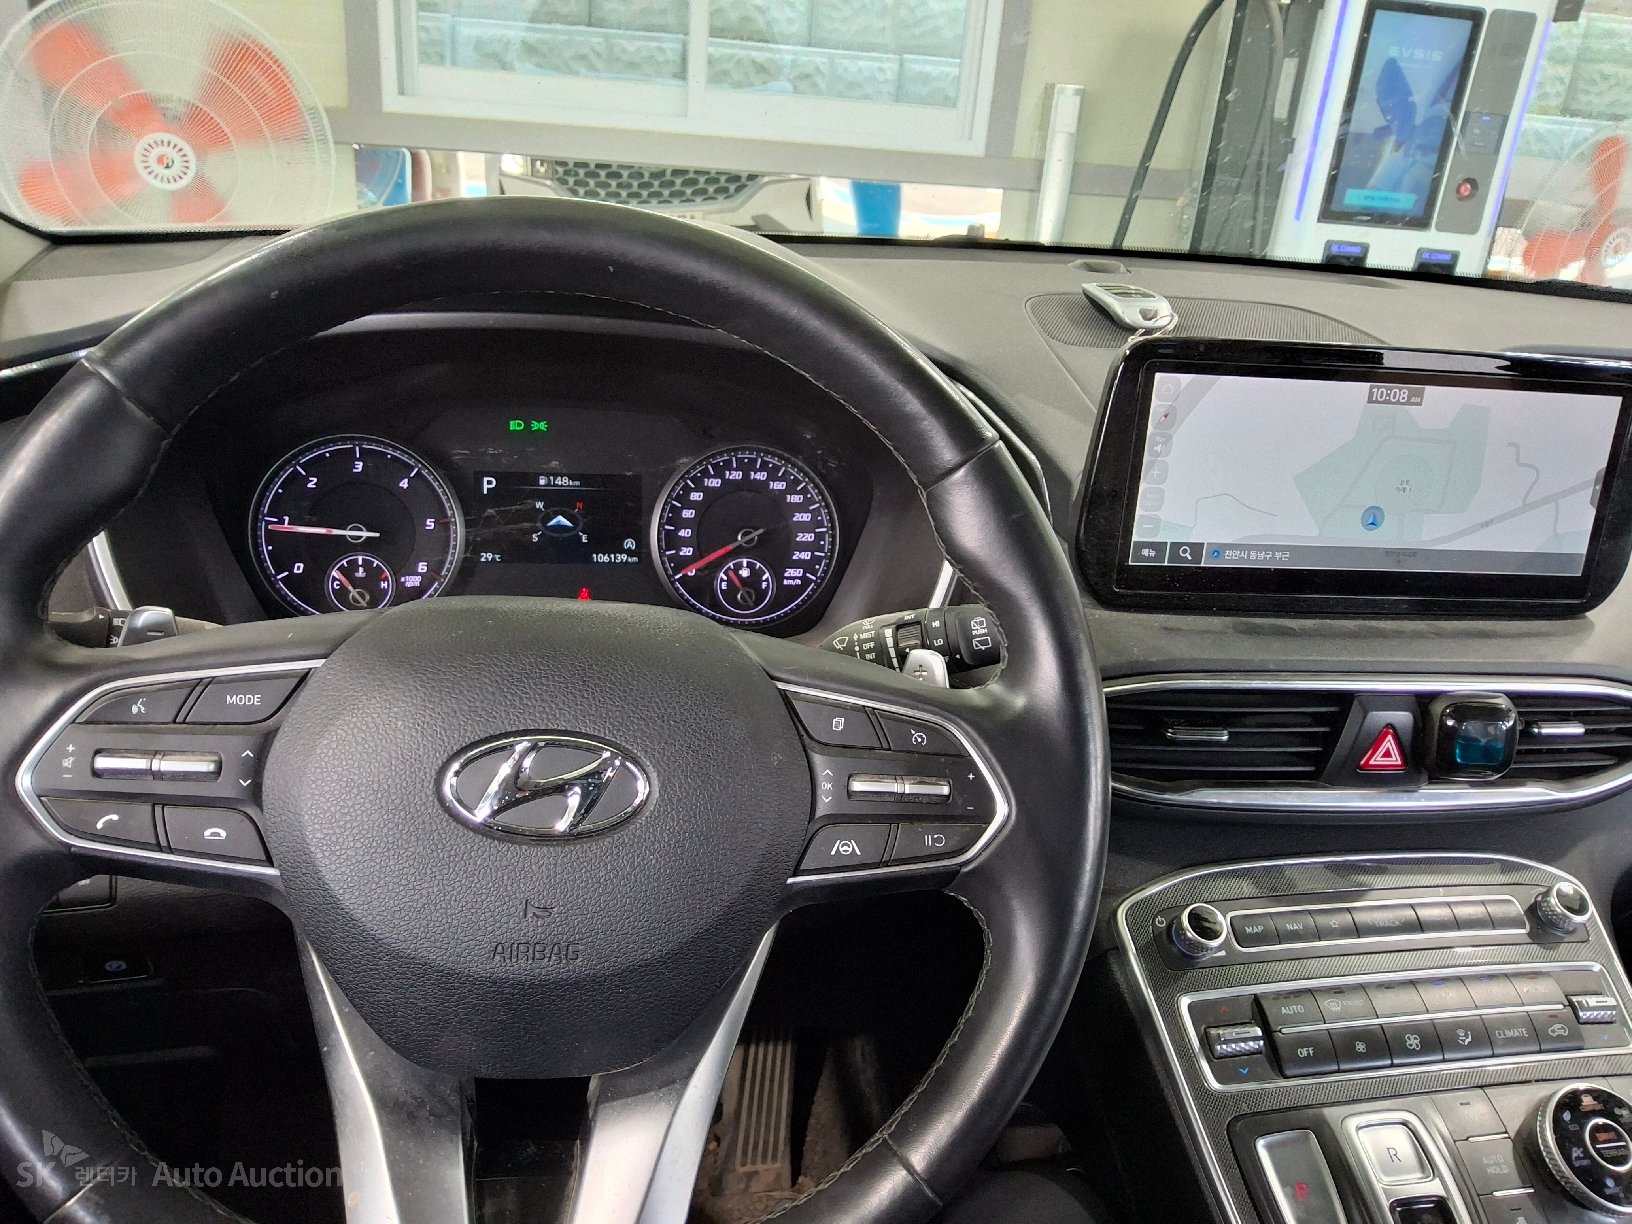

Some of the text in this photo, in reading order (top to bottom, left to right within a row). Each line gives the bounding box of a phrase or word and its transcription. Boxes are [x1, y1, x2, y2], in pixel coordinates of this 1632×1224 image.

[1388, 46, 1442, 61] EVSIS
[1371, 387, 1409, 402] 10:08
[353, 461, 364, 473] 3
[725, 471, 743, 480] 120
[750, 471, 768, 480] 140
[307, 477, 318, 488] 2
[399, 478, 409, 489] 4
[483, 476, 496, 494] P
[549, 476, 581, 486] 148km
[703, 478, 722, 487] 100
[769, 481, 787, 490] 160
[689, 492, 704, 501] 80
[786, 494, 804, 503] 180
[535, 501, 545, 509] W
[576, 501, 583, 509] N
[681, 509, 696, 518] 60
[793, 513, 812, 522] 200
[282, 516, 290, 526] 1
[425, 518, 436, 529] 5
[678, 528, 692, 537] 40
[795, 533, 815, 541] 220
[532, 534, 539, 542] S
[582, 534, 588, 542] E
[679, 547, 693, 556] 20
[792, 551, 812, 560] 240
[1224, 550, 1248, 560] 천안시
[1249, 550, 1273, 561] 동남구
[293, 563, 304, 573] 0
[417, 562, 428, 573] 6
[784, 568, 804, 577] 260
[333, 580, 341, 589] C
[380, 581, 388, 589] H
[783, 578, 802, 586] km/h
[931, 620, 940, 628] HI
[859, 630, 876, 640] MIST
[971, 628, 988, 636] PUSH
[862, 641, 875, 650] OFF
[933, 638, 944, 647] LO
[865, 652, 876, 660] INT
[226, 694, 262, 706] MODE
[821, 782, 833, 791] OK
[1244, 924, 1265, 935] MAP
[1285, 921, 1304, 932] NAV
[491, 942, 580, 963] AIRBAG
[1280, 1004, 1305, 1015] AUTO
[1495, 1027, 1529, 1039] CLIMATE
[1297, 1046, 1315, 1058] OFF
[1386, 1147, 1402, 1163] R
[1482, 1154, 1505, 1165] AUTO
[1486, 1165, 1509, 1175] HOLD
[1294, 1182, 1308, 1200] P
